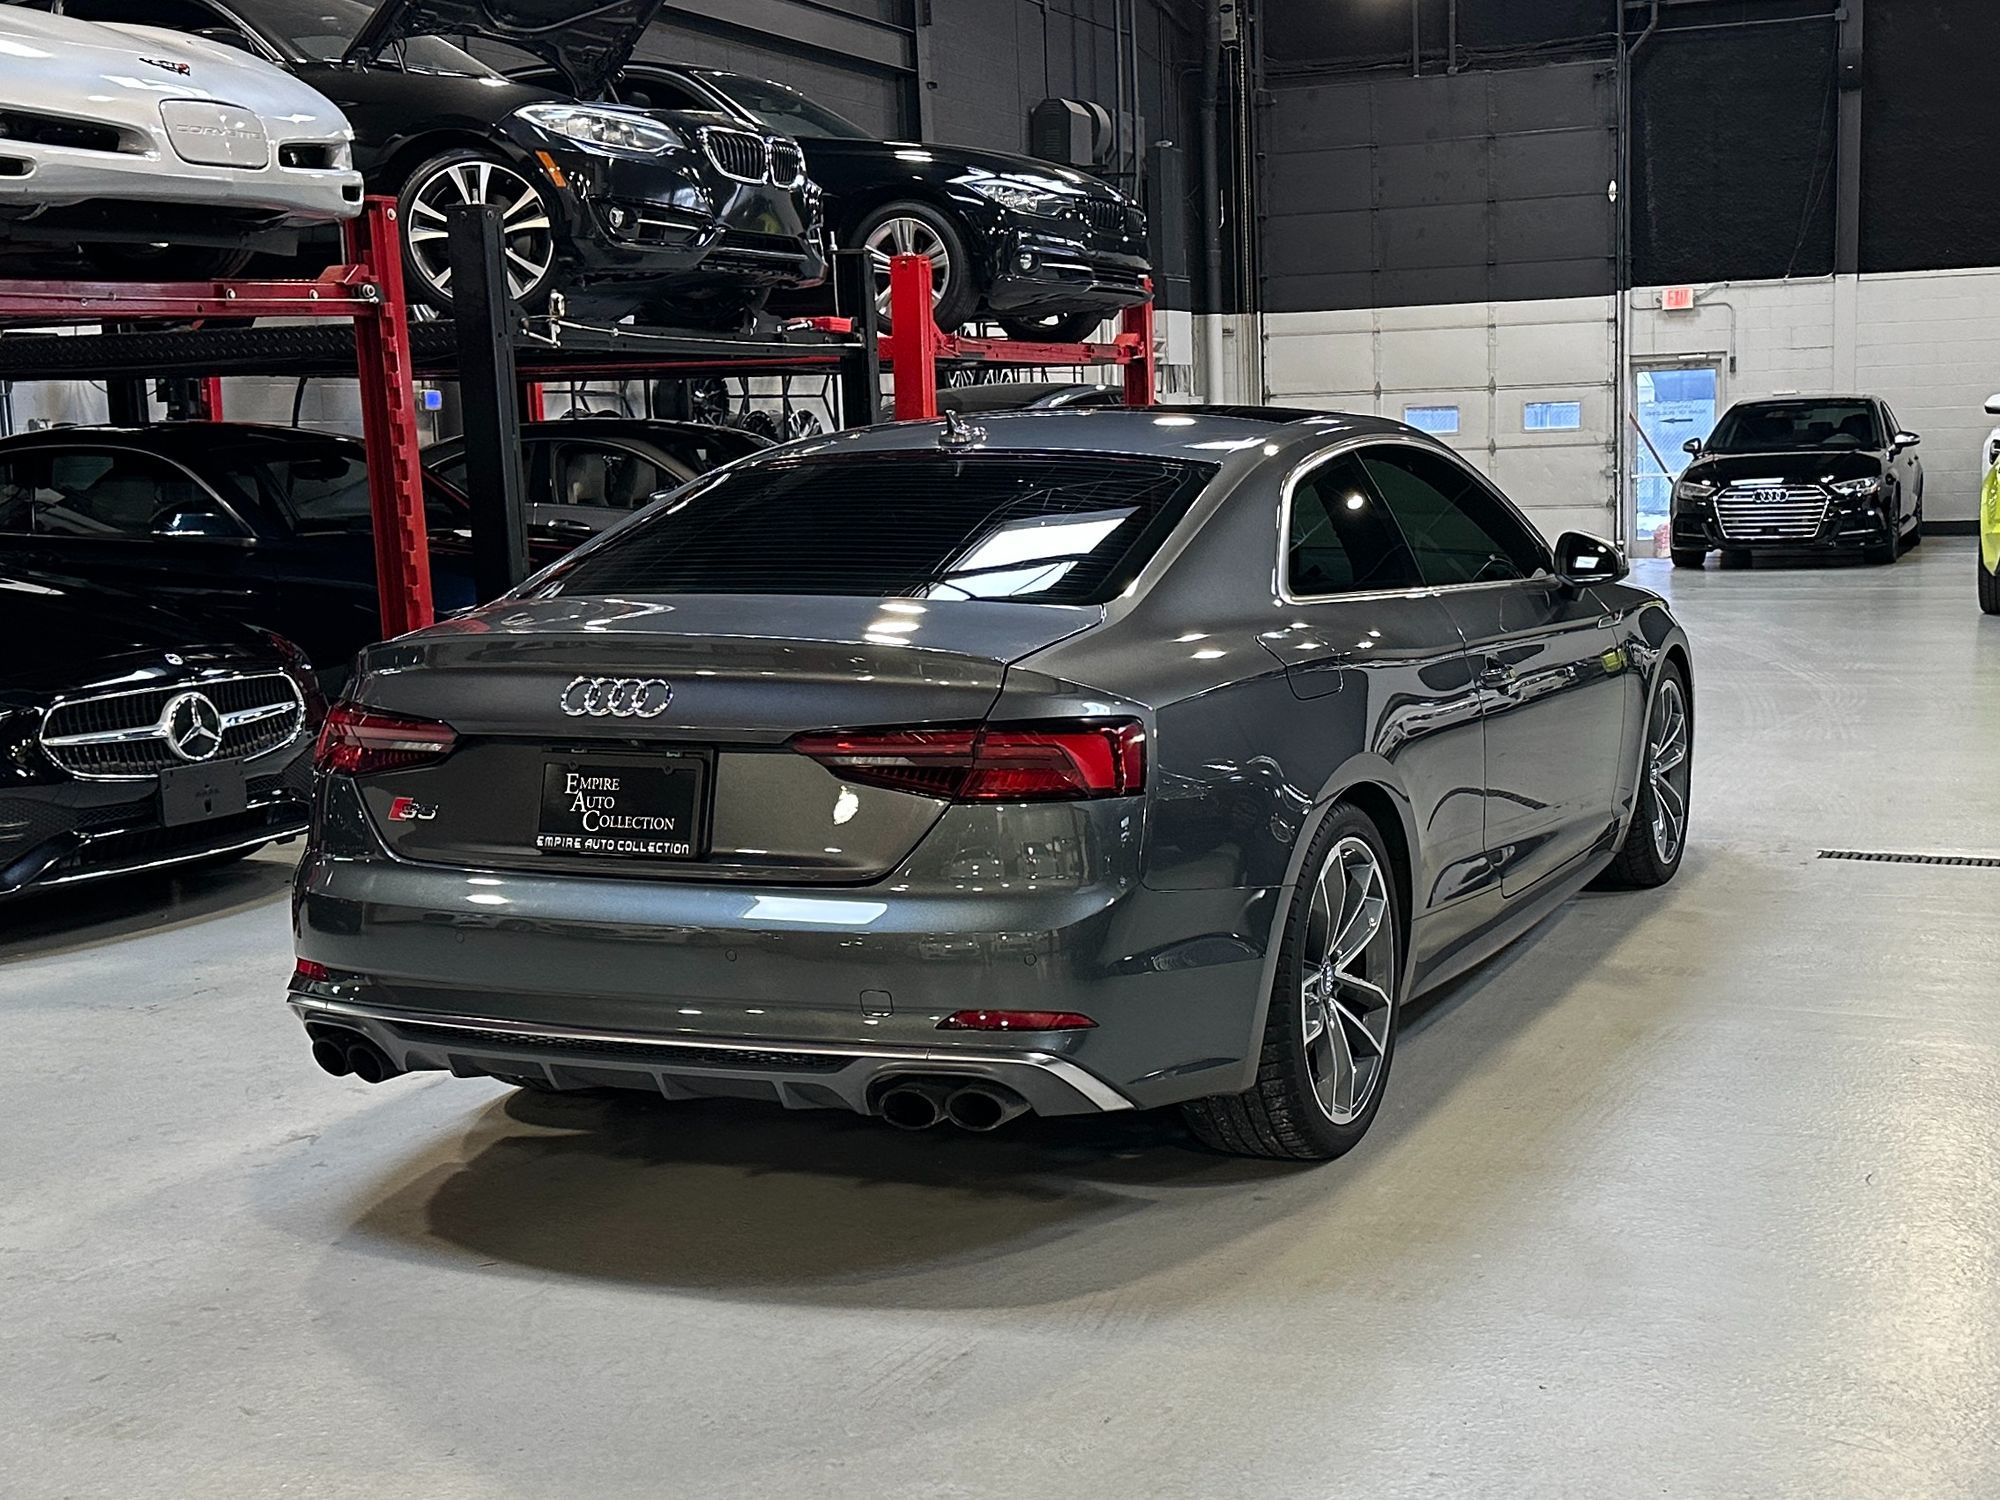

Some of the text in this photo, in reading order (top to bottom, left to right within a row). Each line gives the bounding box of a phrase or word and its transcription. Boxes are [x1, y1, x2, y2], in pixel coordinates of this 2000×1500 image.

[564, 773, 620, 794] EMPIRE
[570, 791, 615, 812] AUTO
[582, 810, 675, 832] COLLECTION
[536, 835, 689, 855] EMPIRE AUTO COLLECTION
